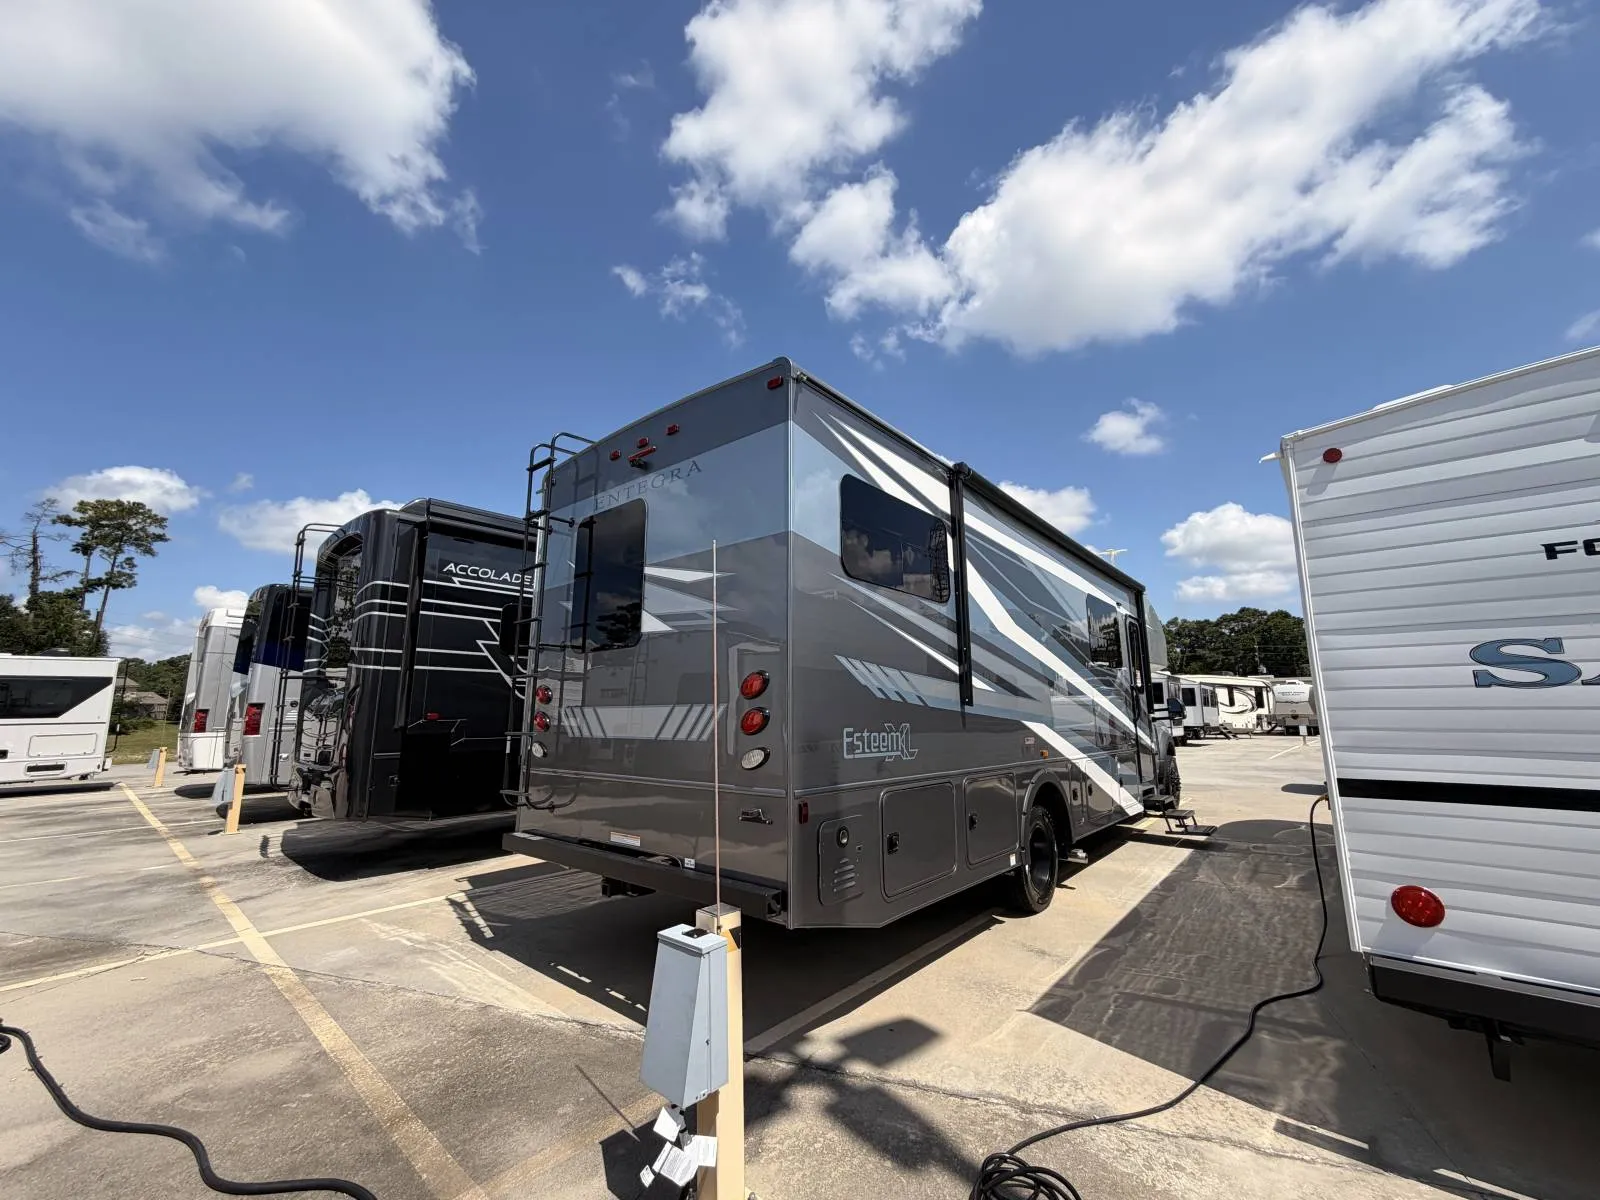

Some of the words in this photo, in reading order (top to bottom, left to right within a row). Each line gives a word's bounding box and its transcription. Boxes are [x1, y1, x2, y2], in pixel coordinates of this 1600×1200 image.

[594, 460, 702, 512] ENTEGRA
[443, 563, 532, 585] ACCOLADE
[1469, 637, 1600, 689] S
